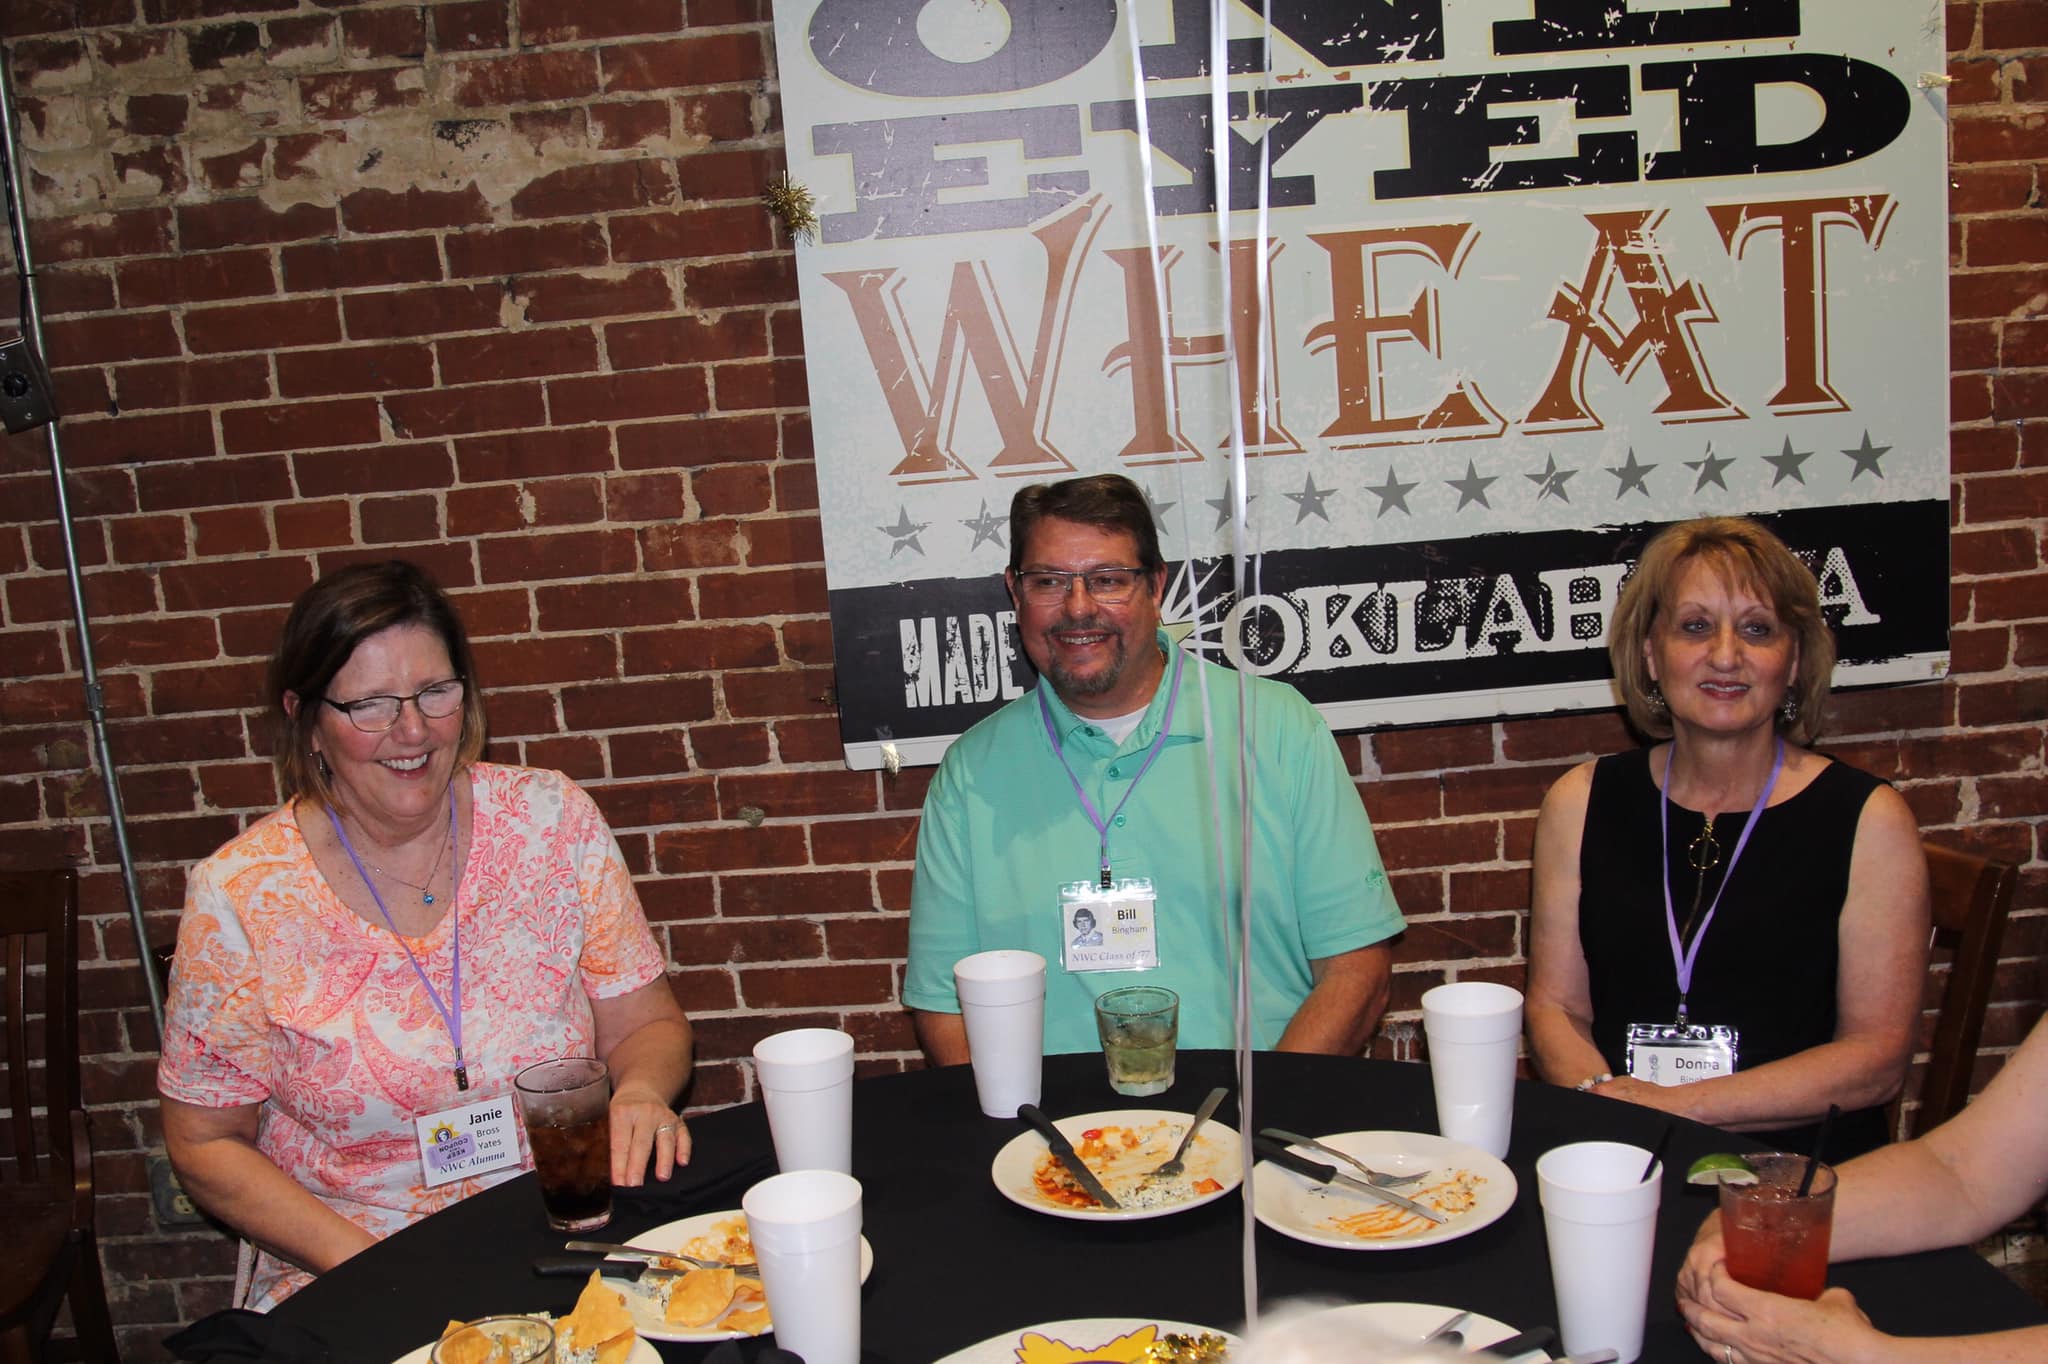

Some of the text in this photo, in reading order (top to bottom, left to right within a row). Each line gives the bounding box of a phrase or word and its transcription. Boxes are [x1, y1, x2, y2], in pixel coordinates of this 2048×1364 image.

[812, 53, 1911, 244] EYED
[821, 192, 1900, 486] WHEAT
[899, 547, 1881, 708] MADE OKLAHA
[1117, 908, 1136, 920] Bill
[1111, 926, 1148, 936] Bingham
[1072, 953, 1098, 962] NWC
[1099, 951, 1125, 961] Class
[1126, 950, 1136, 960] of
[1675, 1057, 1720, 1070] Donna
[469, 1108, 503, 1126] Janie
[476, 1126, 500, 1138] Bross
[477, 1138, 502, 1151] Yates
[440, 1151, 506, 1175] NWC Alumna
